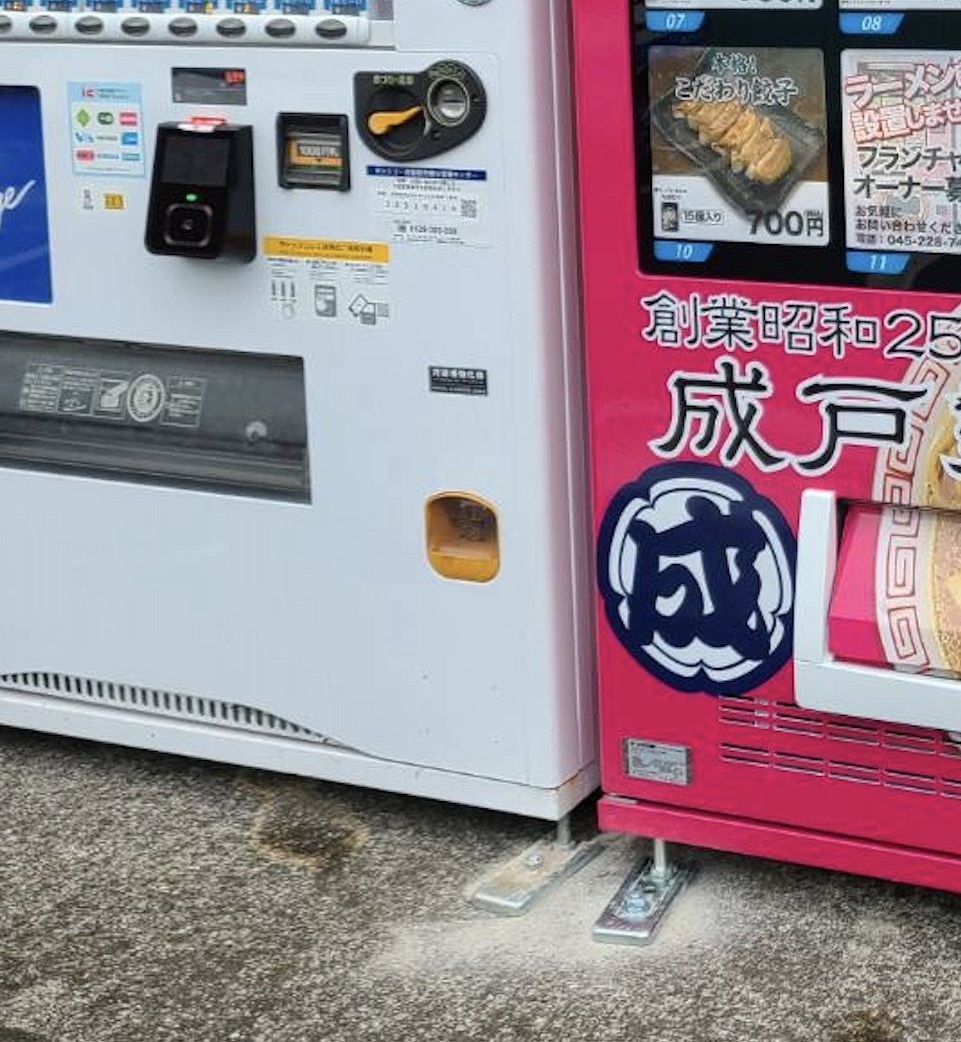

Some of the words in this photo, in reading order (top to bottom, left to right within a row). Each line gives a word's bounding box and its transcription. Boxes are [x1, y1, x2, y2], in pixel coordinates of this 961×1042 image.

[665, 13, 685, 29] 07
[862, 16, 882, 31] 08
[674, 76, 799, 106] こだわり餃子
[748, 211, 824, 237] 700円
[676, 244, 694, 259] 10
[870, 255, 887, 270] 11
